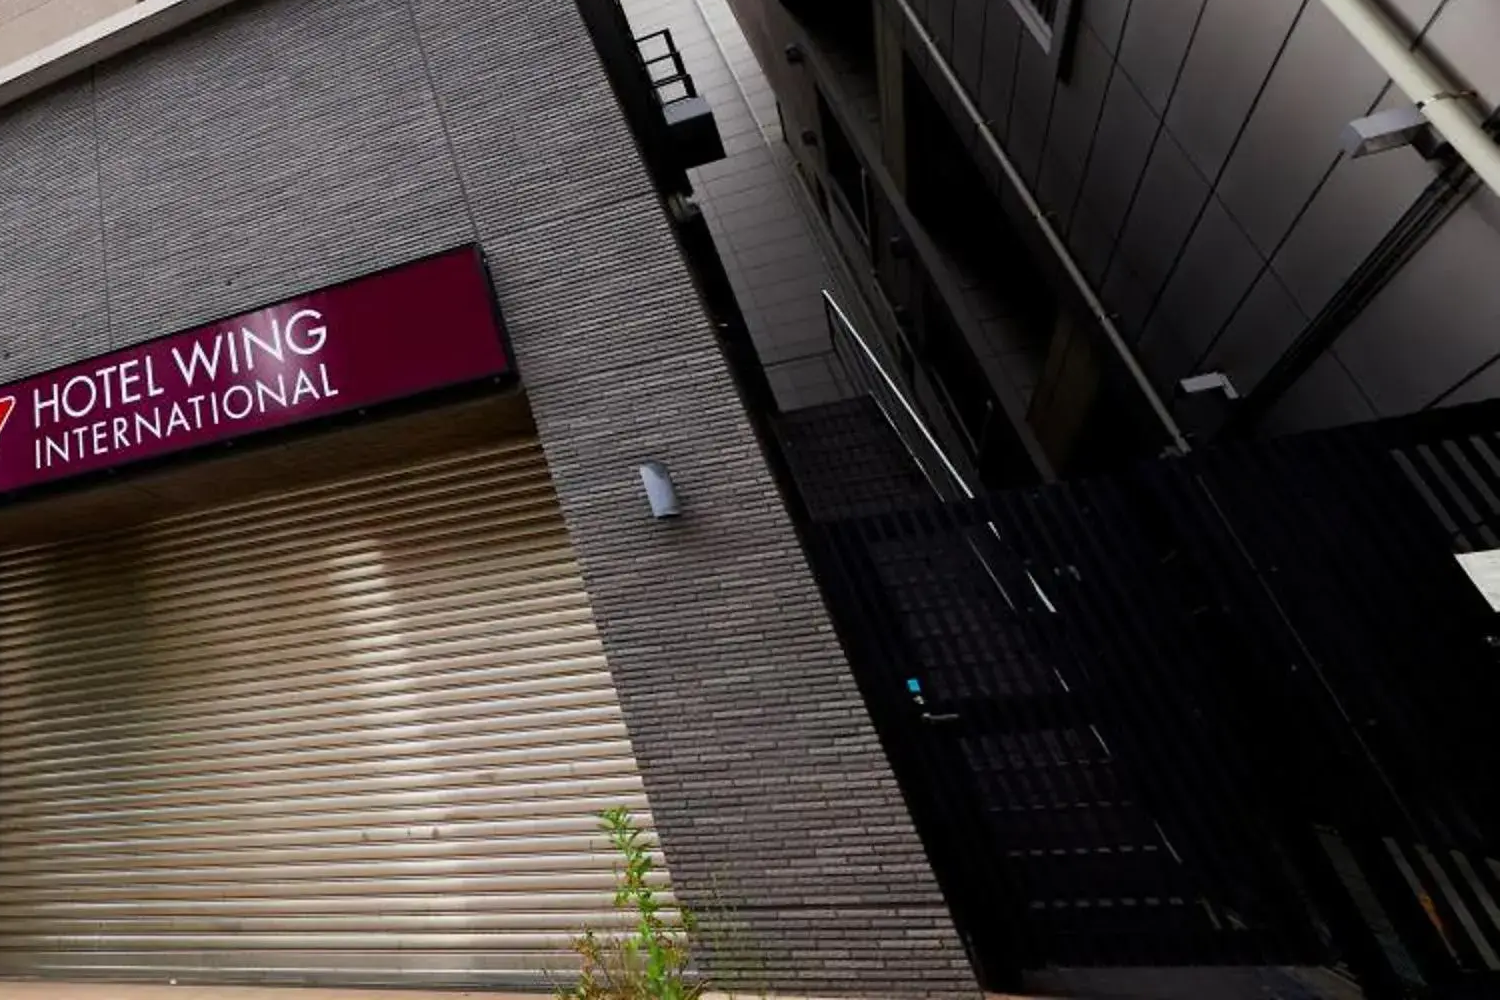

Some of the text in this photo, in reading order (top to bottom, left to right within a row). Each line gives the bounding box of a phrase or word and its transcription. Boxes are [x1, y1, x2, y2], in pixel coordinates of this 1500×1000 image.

[33, 309, 328, 428] HOTEL WING
[35, 363, 339, 469] INTERNATIONAL
